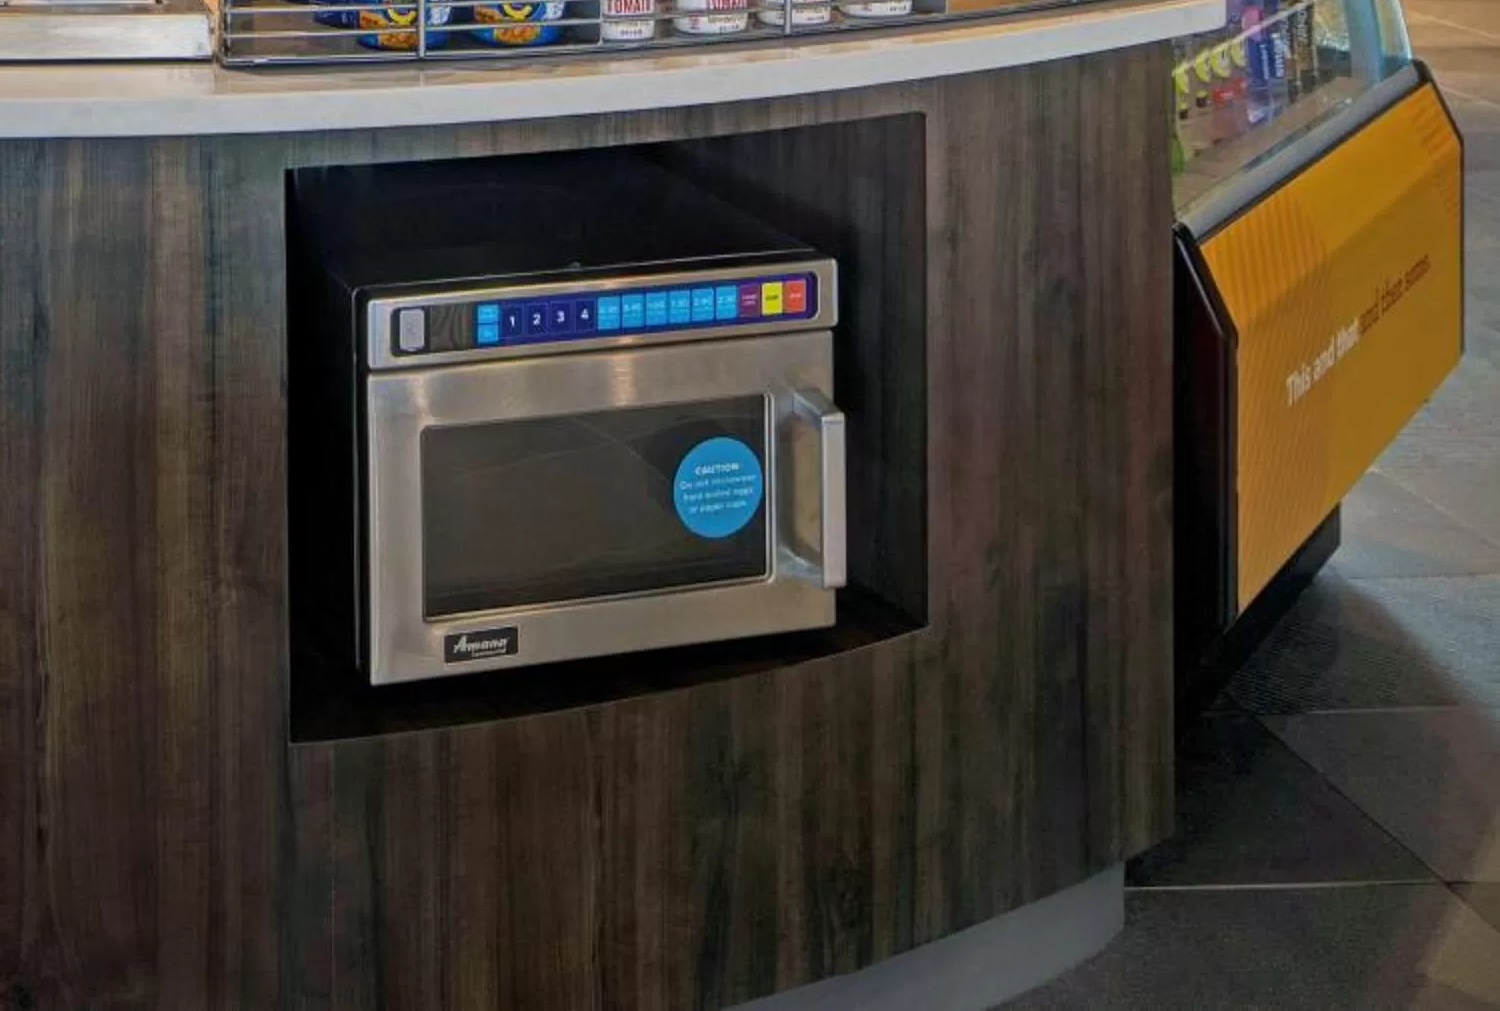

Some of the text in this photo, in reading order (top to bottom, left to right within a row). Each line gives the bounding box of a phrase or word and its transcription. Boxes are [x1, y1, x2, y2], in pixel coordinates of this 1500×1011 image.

[509, 308, 589, 328] 1 2 3 4
